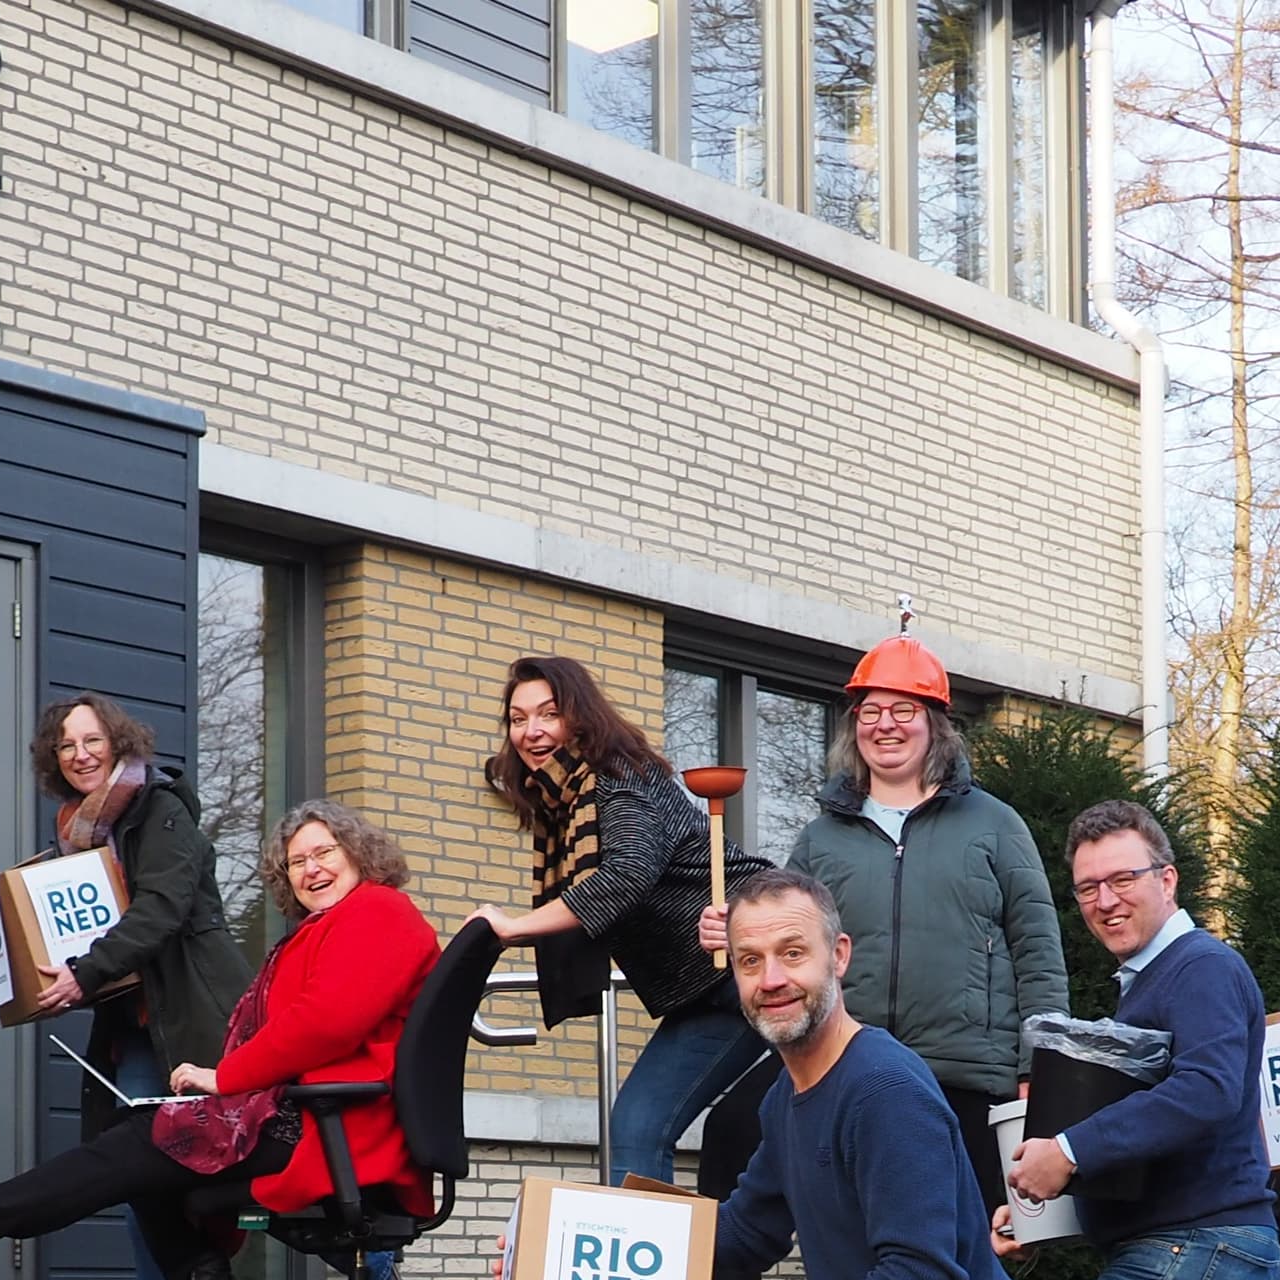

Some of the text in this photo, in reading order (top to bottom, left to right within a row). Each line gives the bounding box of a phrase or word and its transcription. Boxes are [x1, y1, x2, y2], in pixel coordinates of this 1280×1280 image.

[47, 882, 98, 914] RIO
[54, 905, 111, 936] NED
[572, 1233, 663, 1277] RIO
